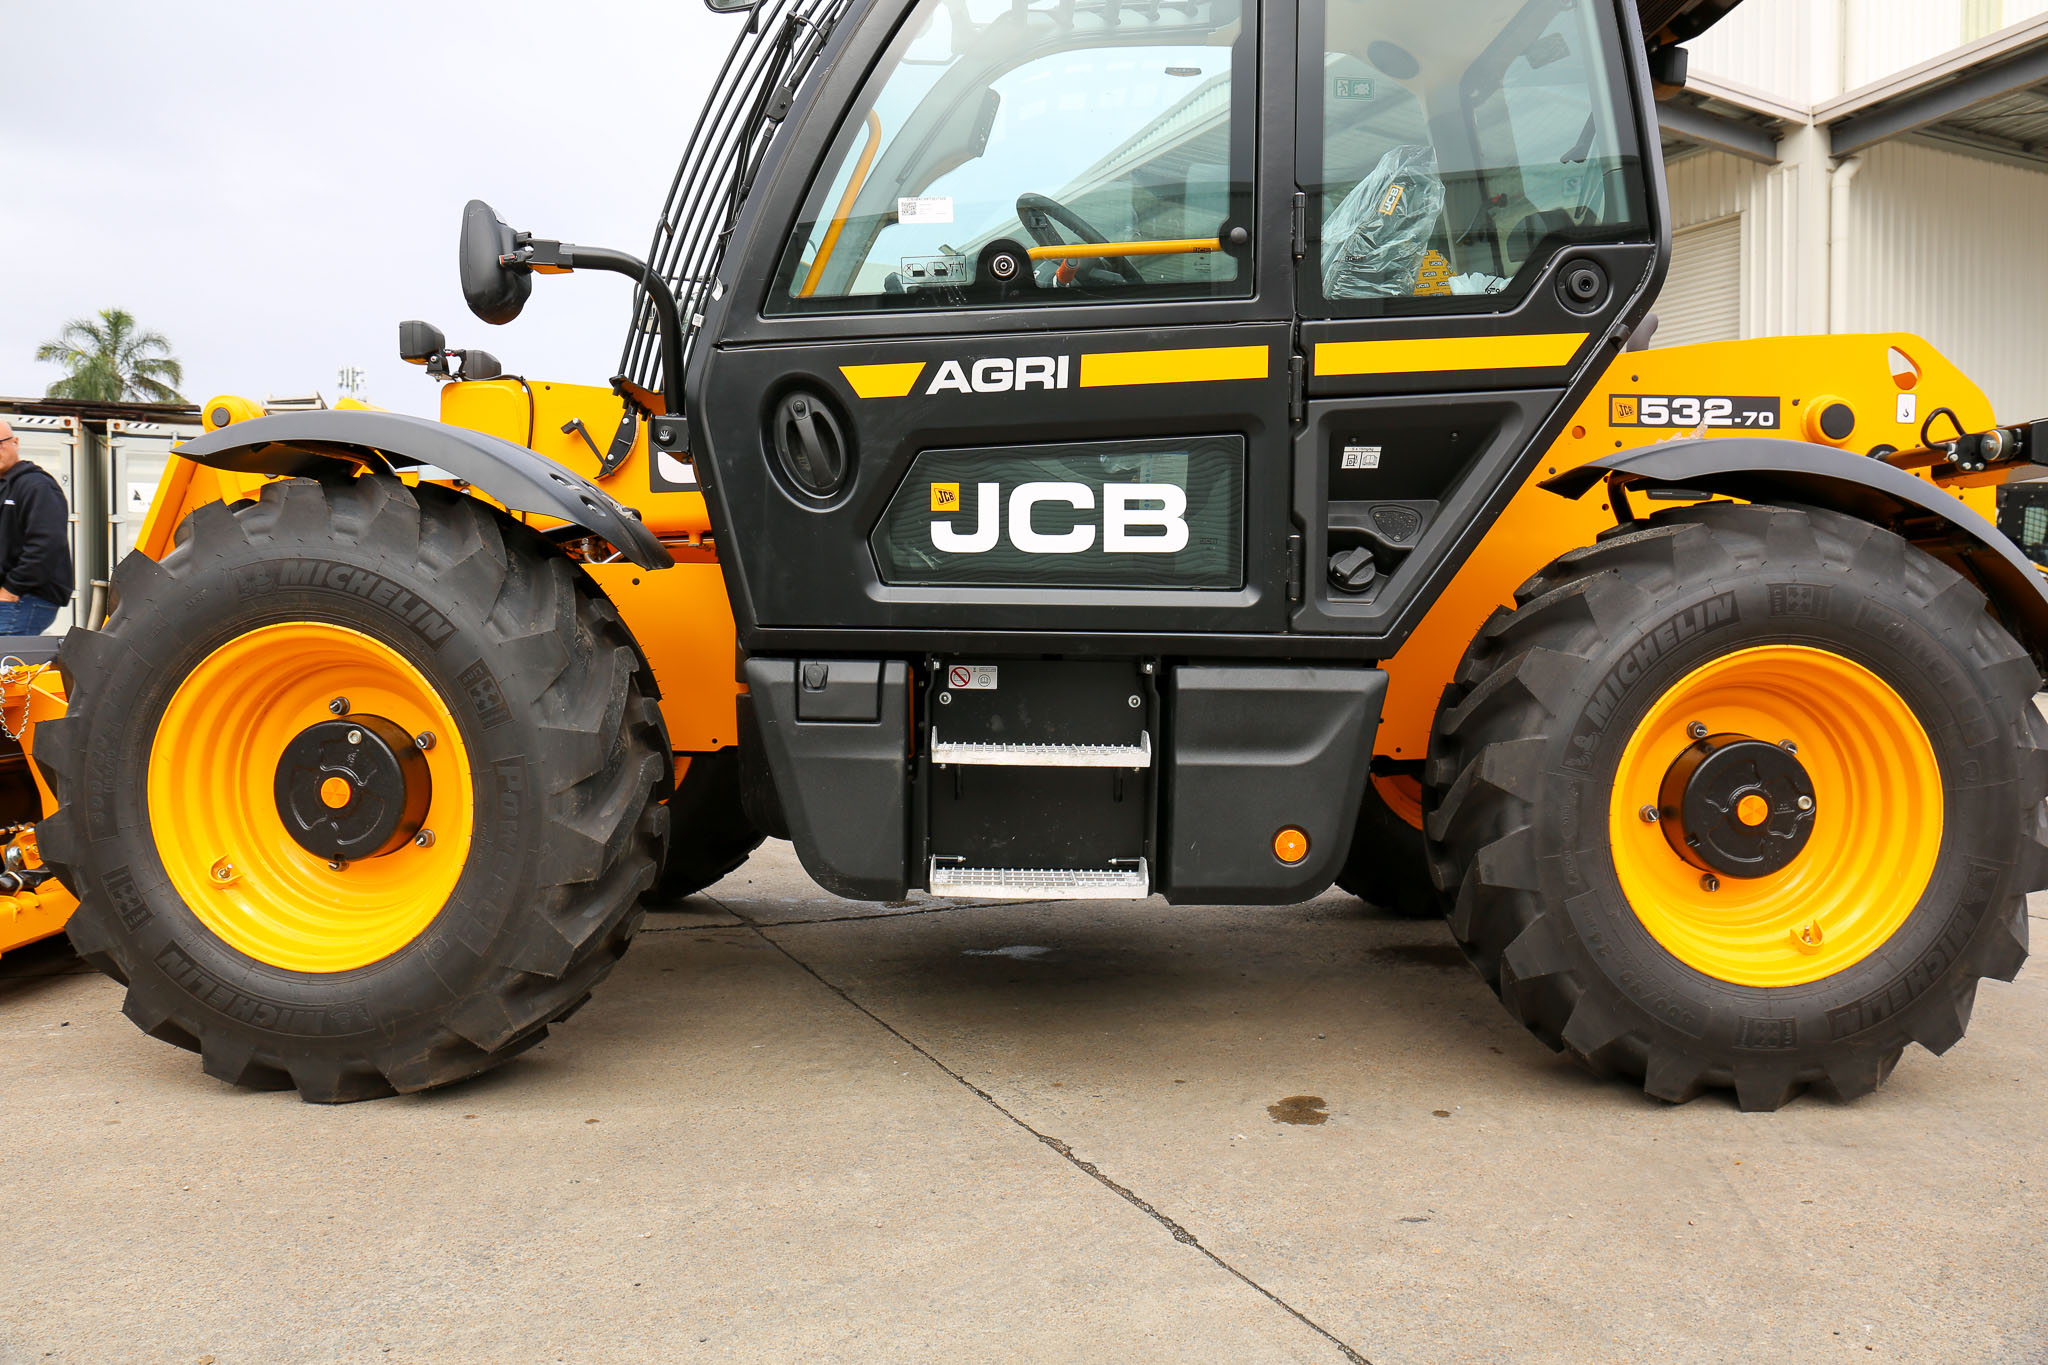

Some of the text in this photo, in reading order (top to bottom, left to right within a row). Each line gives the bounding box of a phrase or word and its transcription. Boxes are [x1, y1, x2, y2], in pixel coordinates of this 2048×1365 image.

[1384, 187, 1399, 211] JCB
[925, 355, 1069, 395] AGRI
[1618, 397, 1774, 427] JCB 532-70
[931, 481, 1189, 553] JCB
[938, 490, 954, 503] JCB
[279, 561, 451, 641] MICHELIN
[1586, 593, 1735, 727] MICHELIN
[156, 951, 326, 1034] MICHELIN
[1832, 907, 1976, 1036] MICHELIN
